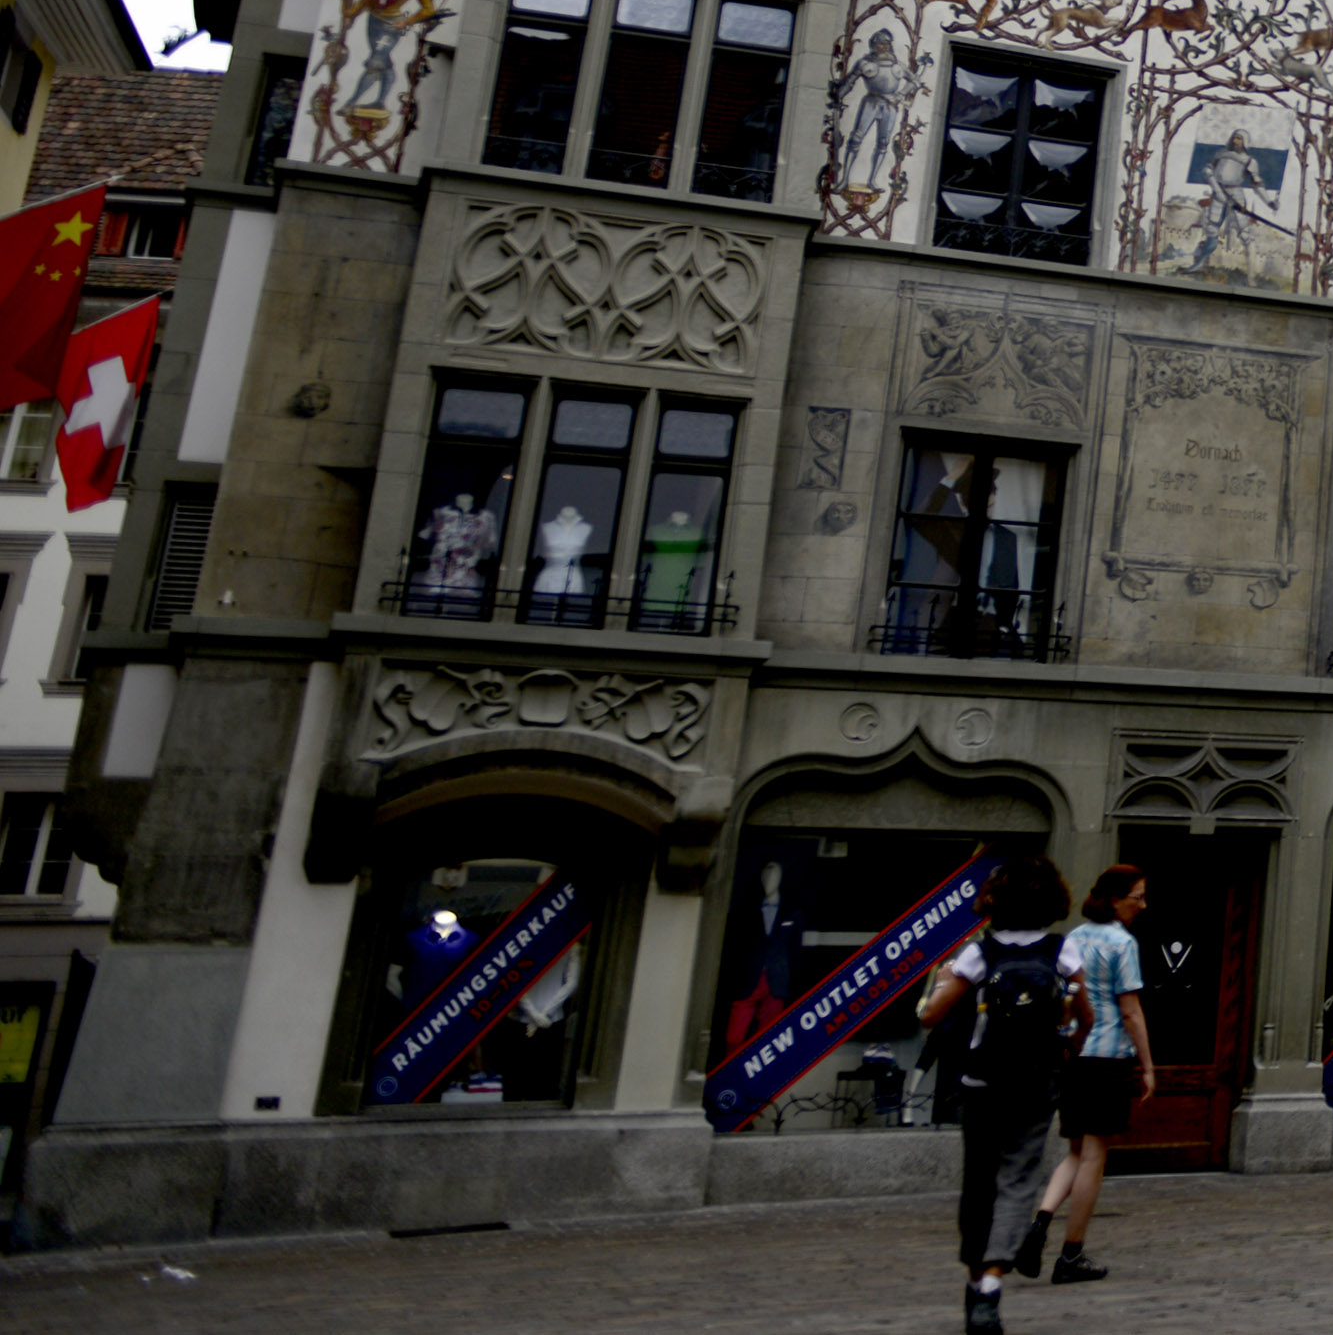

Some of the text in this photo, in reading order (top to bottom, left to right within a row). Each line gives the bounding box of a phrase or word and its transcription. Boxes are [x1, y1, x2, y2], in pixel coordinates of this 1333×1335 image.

[391, 882, 576, 1072] RÄUMUNGSVERKAUF
[744, 879, 977, 1079] NEW OUTLET OPENING
[825, 948, 925, 1037] AM 01.09.2016
